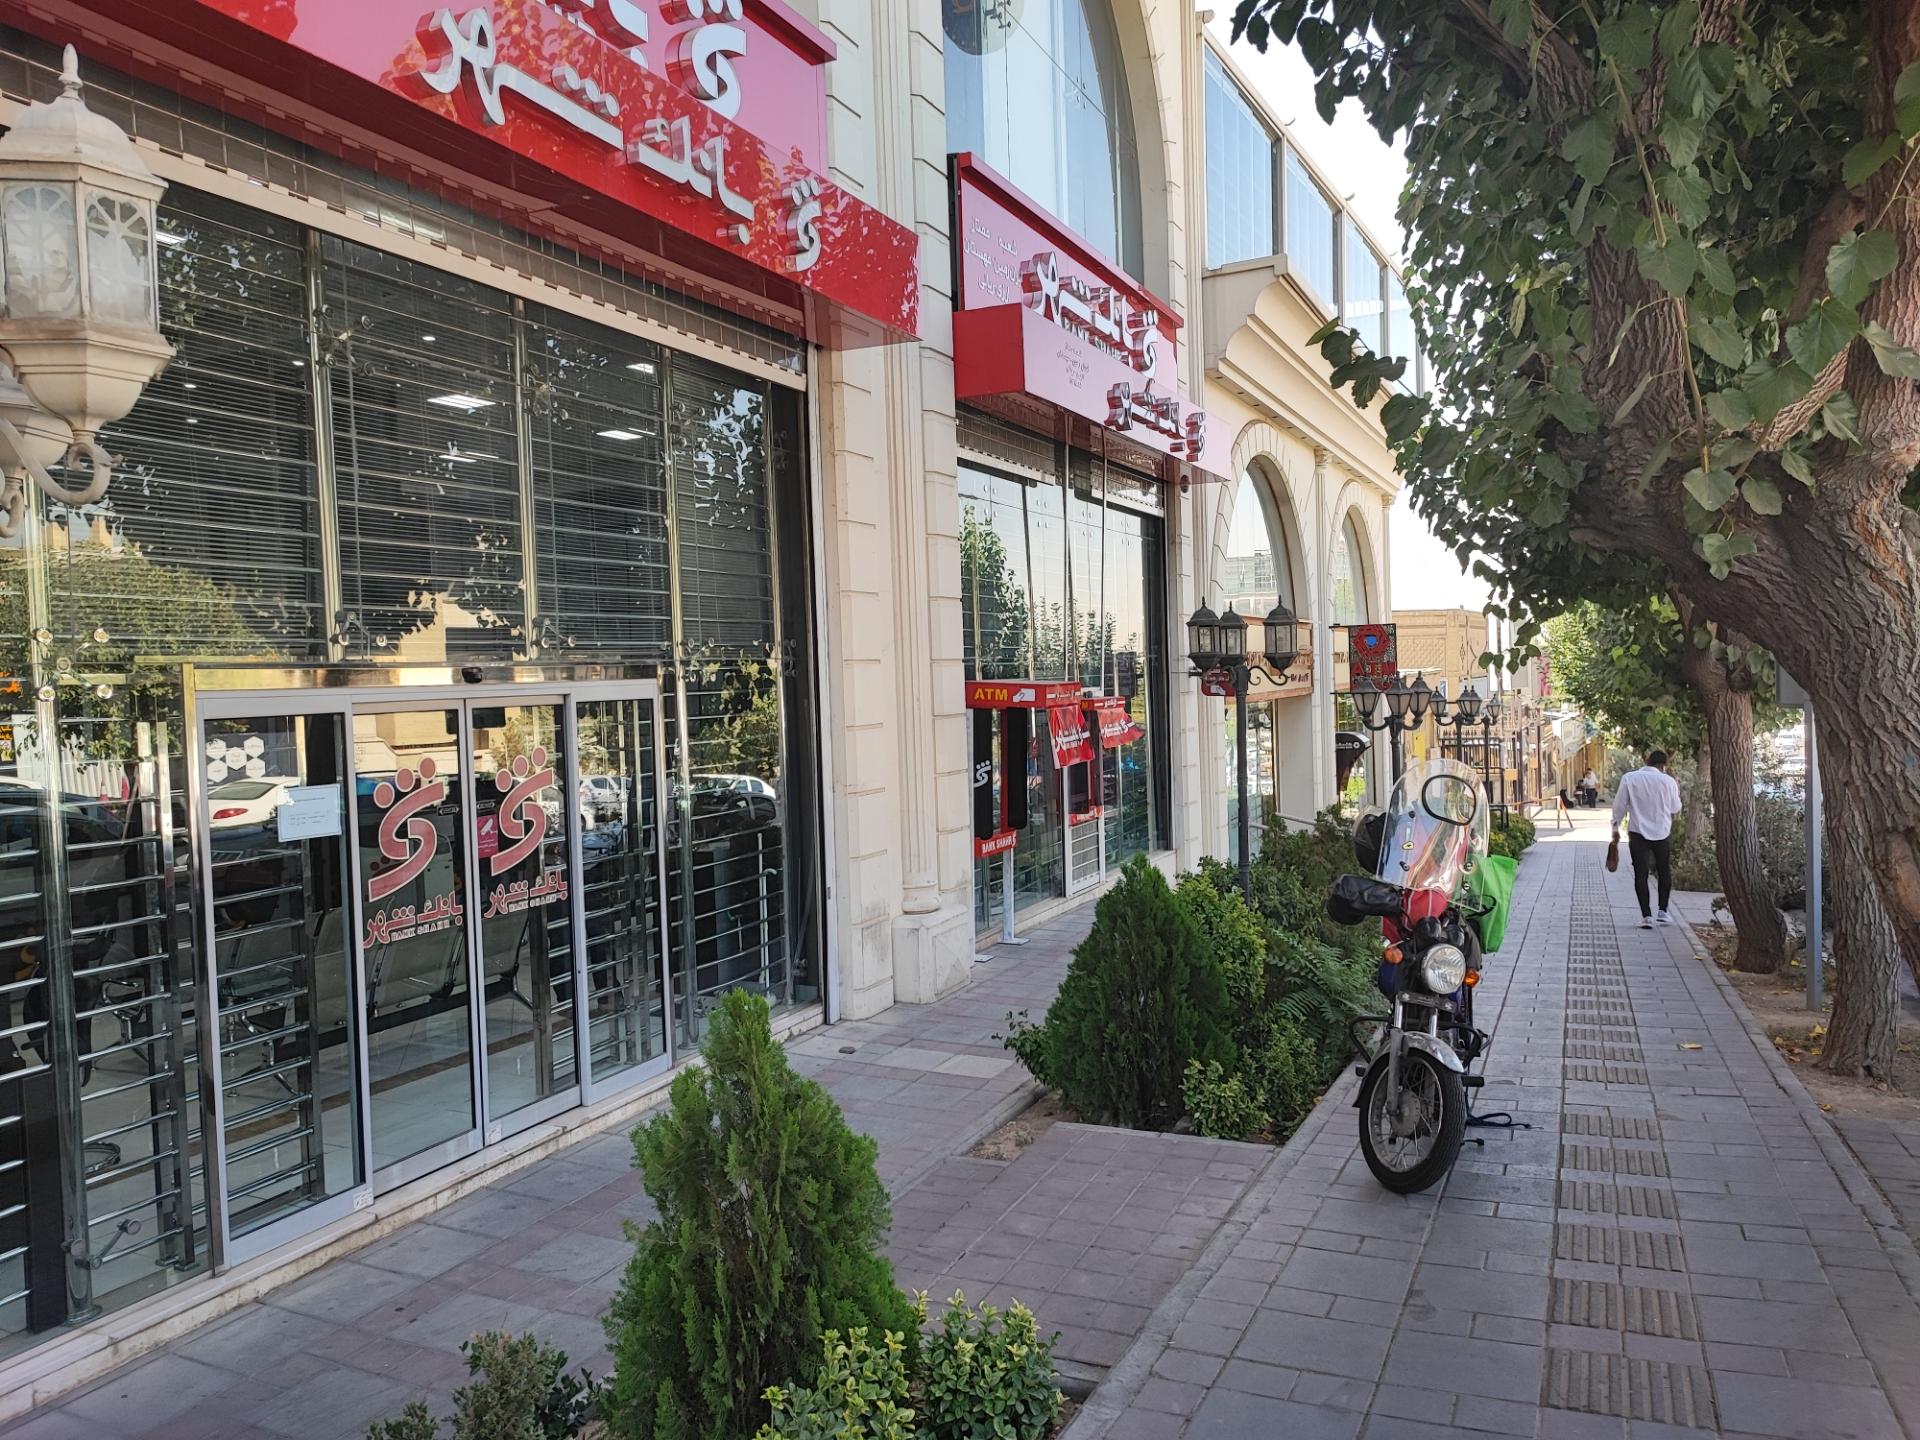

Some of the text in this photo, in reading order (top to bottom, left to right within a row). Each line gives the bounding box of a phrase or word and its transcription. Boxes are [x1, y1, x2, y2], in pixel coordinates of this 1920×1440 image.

[400, 5, 624, 151] شهر
[633, 115, 754, 246] بانک
[1026, 251, 1093, 326] شهر
[973, 687, 1009, 702] ATM
[982, 840, 996, 854] BANK
[363, 890, 463, 949] بانک شهر
[484, 869, 568, 919] بانک شهر
[390, 919, 450, 942] BANK SHAHR
